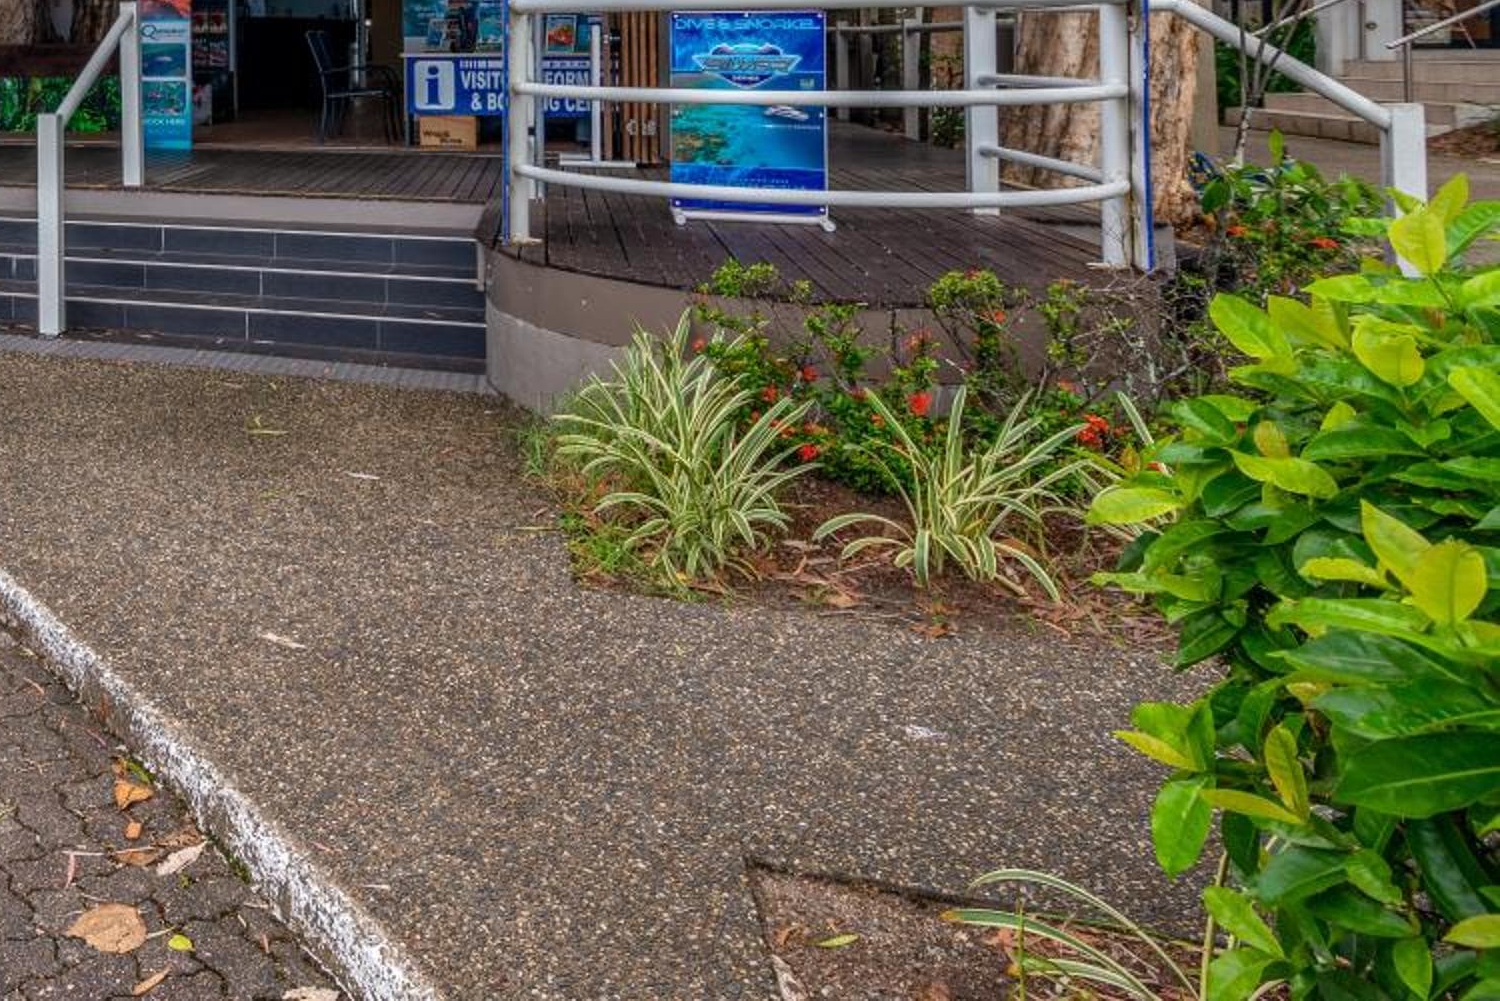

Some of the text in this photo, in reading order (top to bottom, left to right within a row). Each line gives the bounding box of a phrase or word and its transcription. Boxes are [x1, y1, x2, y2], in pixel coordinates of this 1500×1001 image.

[675, 18, 715, 30] DIVE
[734, 17, 821, 30] SNORKEL
[461, 70, 504, 90] VISIT
[471, 92, 483, 111] &
